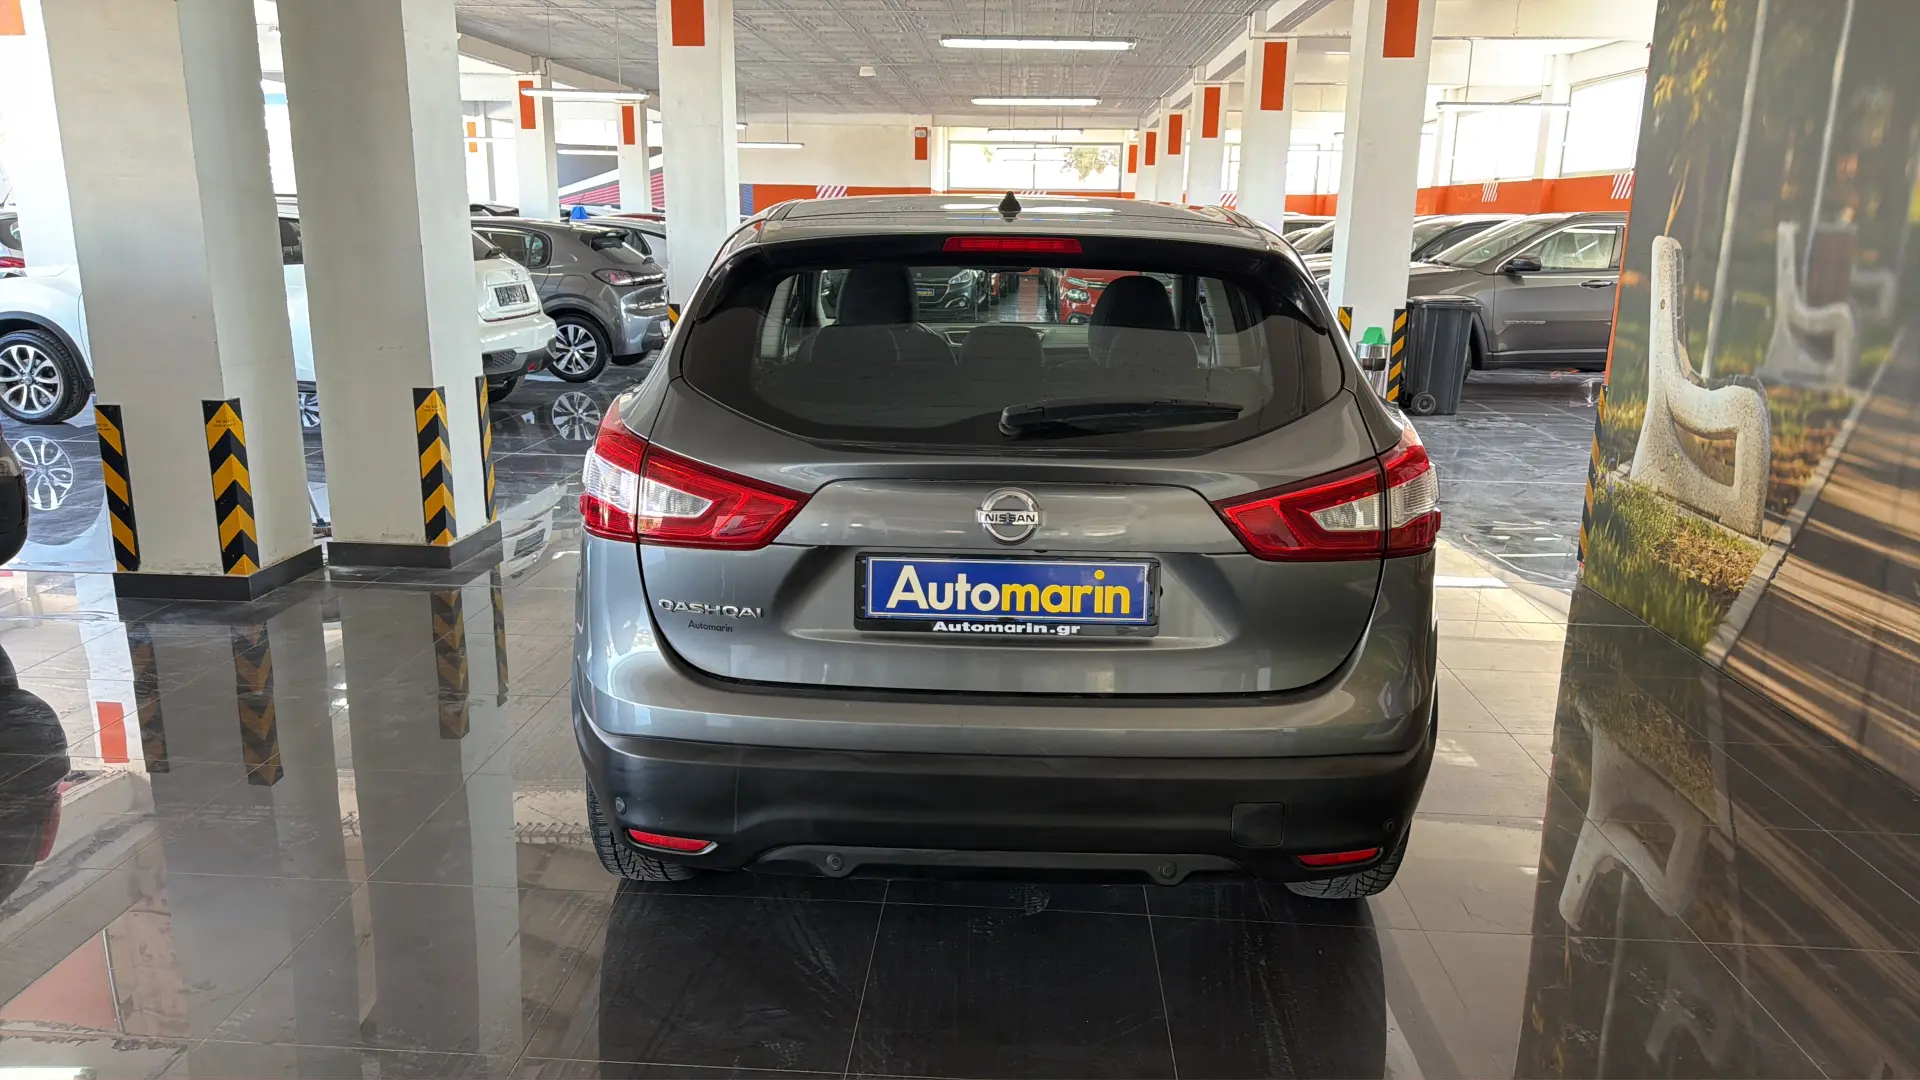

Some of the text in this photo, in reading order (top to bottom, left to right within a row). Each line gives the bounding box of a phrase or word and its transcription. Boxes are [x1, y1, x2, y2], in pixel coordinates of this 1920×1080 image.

[985, 513, 1035, 523] NISSAN
[886, 564, 1130, 614] Automarin
[658, 598, 762, 619] QASHQAI
[687, 620, 733, 633] Automarin
[932, 620, 1080, 636] Automarin.gr
